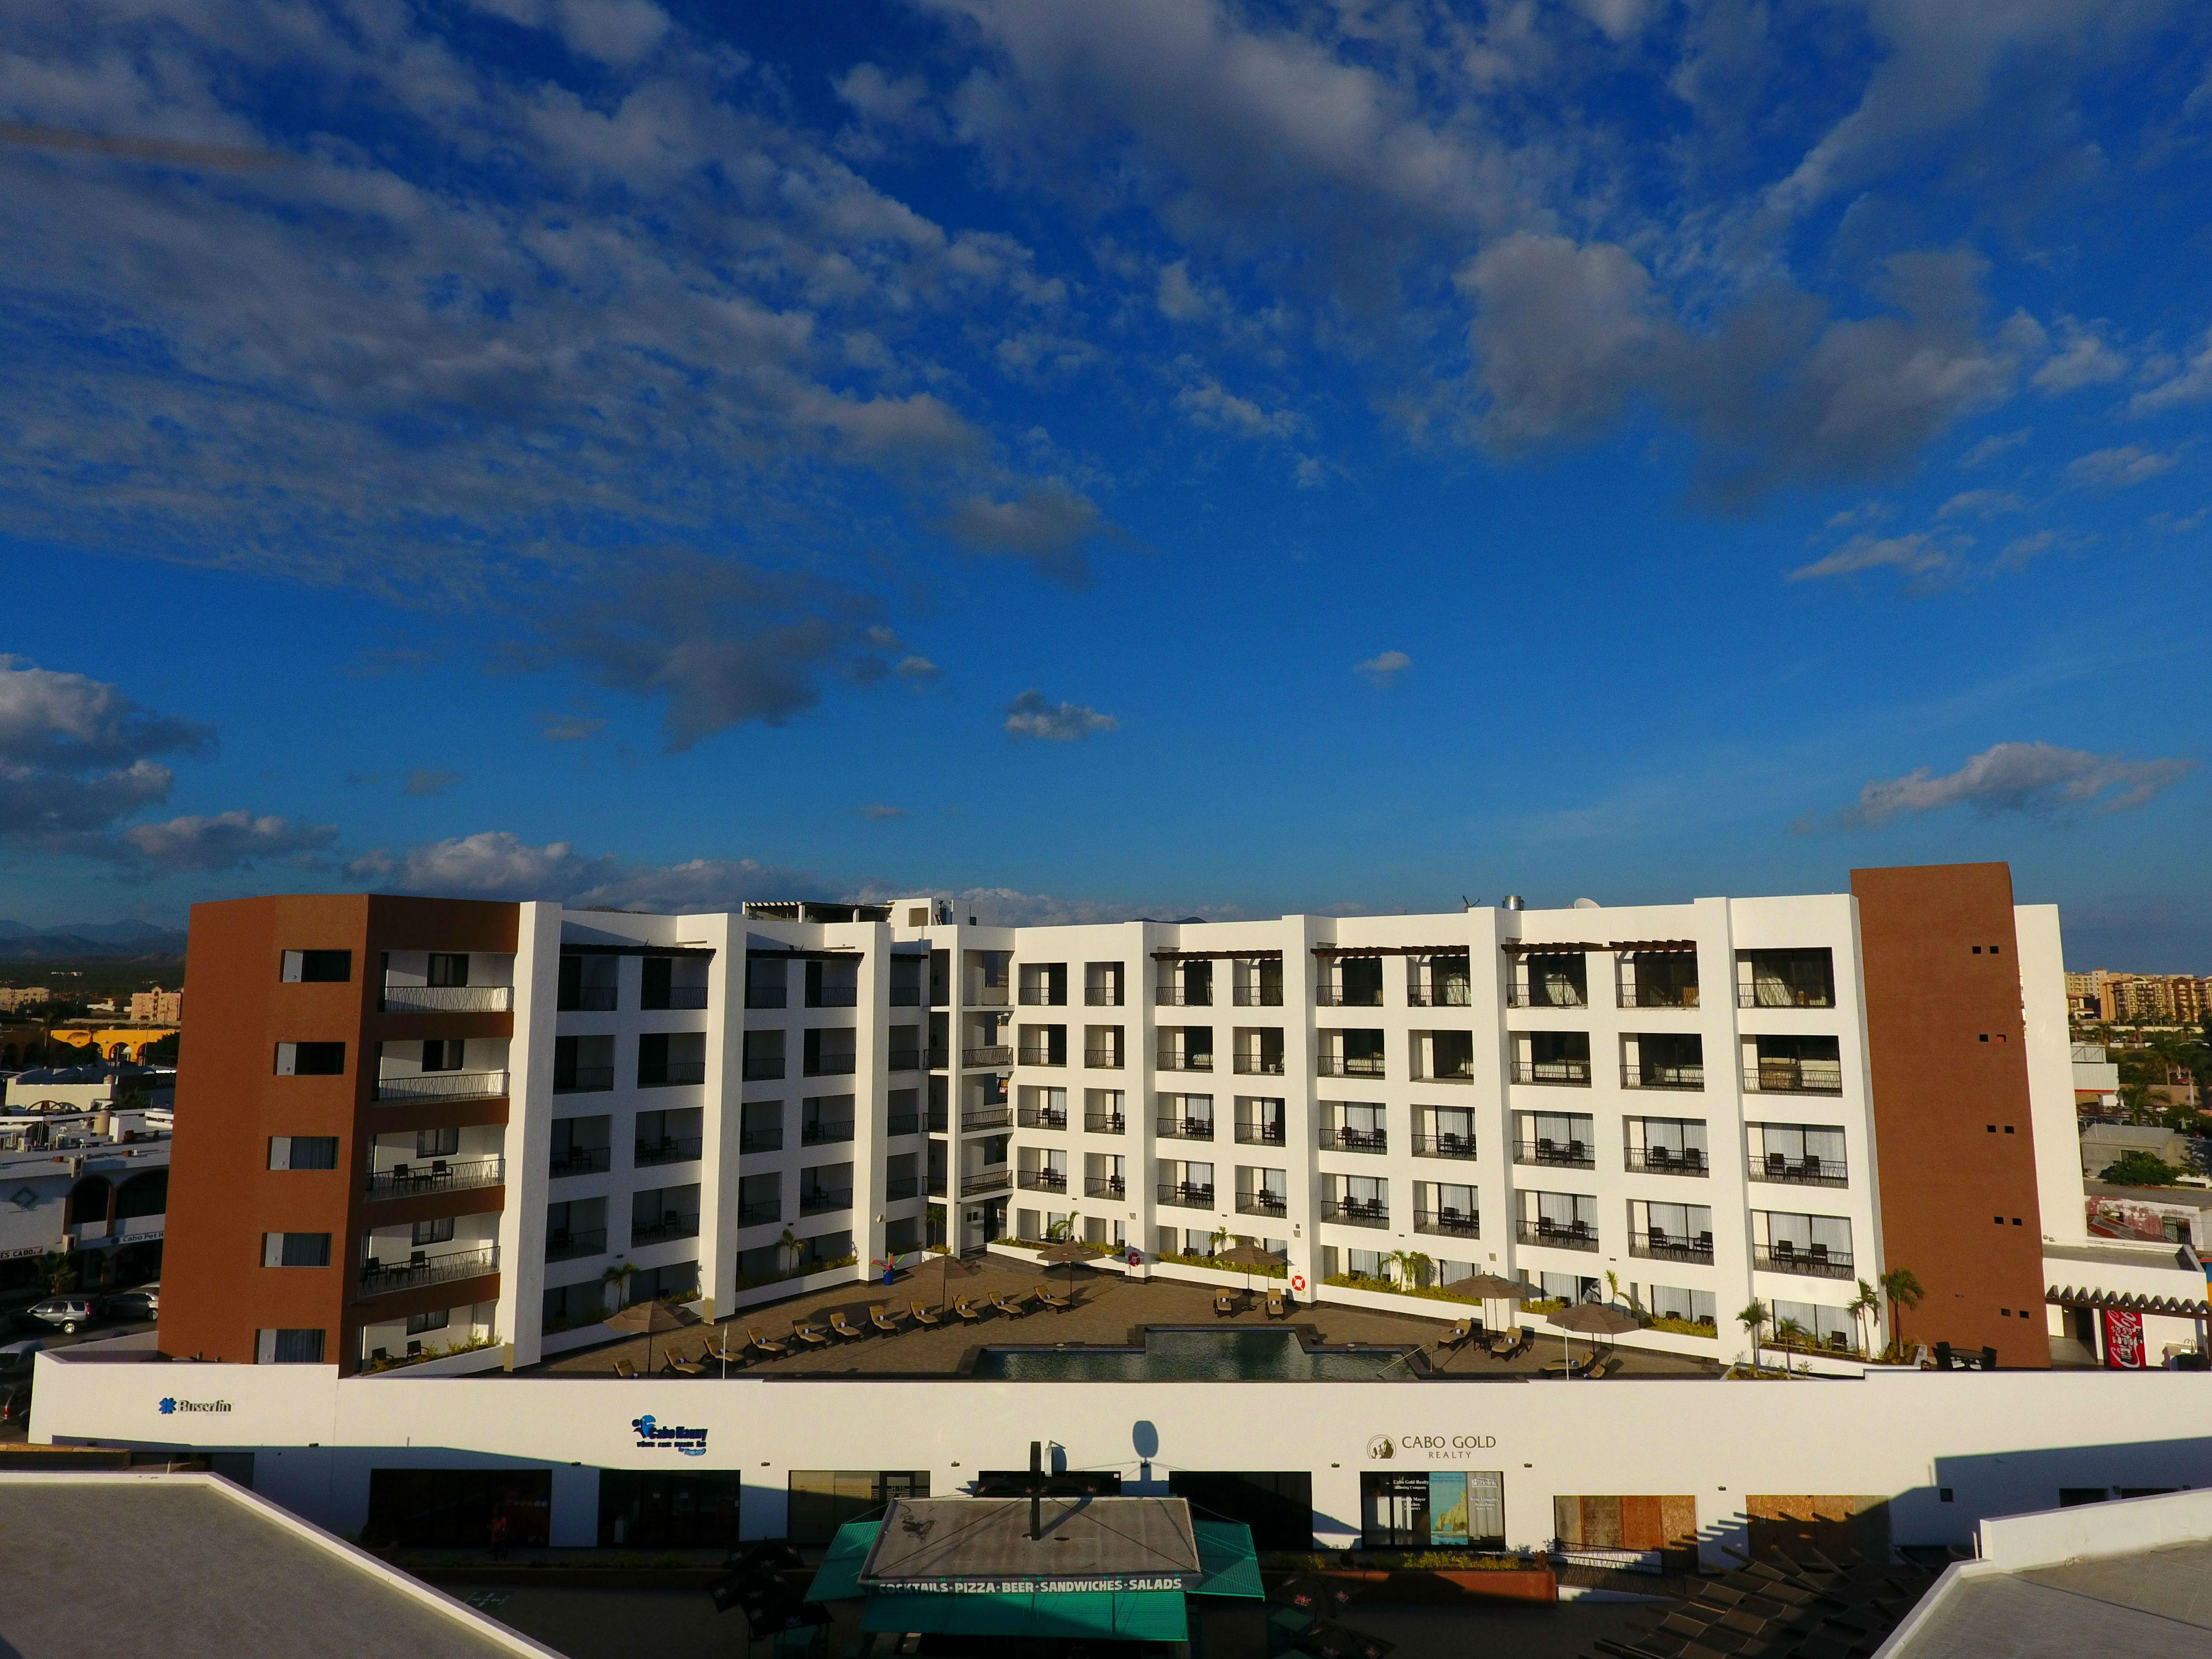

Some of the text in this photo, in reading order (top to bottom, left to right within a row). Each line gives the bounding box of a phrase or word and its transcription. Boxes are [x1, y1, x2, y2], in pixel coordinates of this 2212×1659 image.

[649, 1426, 675, 1439] Cabo
[1402, 1436, 1496, 1448] CABO GOLD
[879, 1578, 1182, 1593] COCKTAILS PIZZA BEER SANDWICHES SALADS
